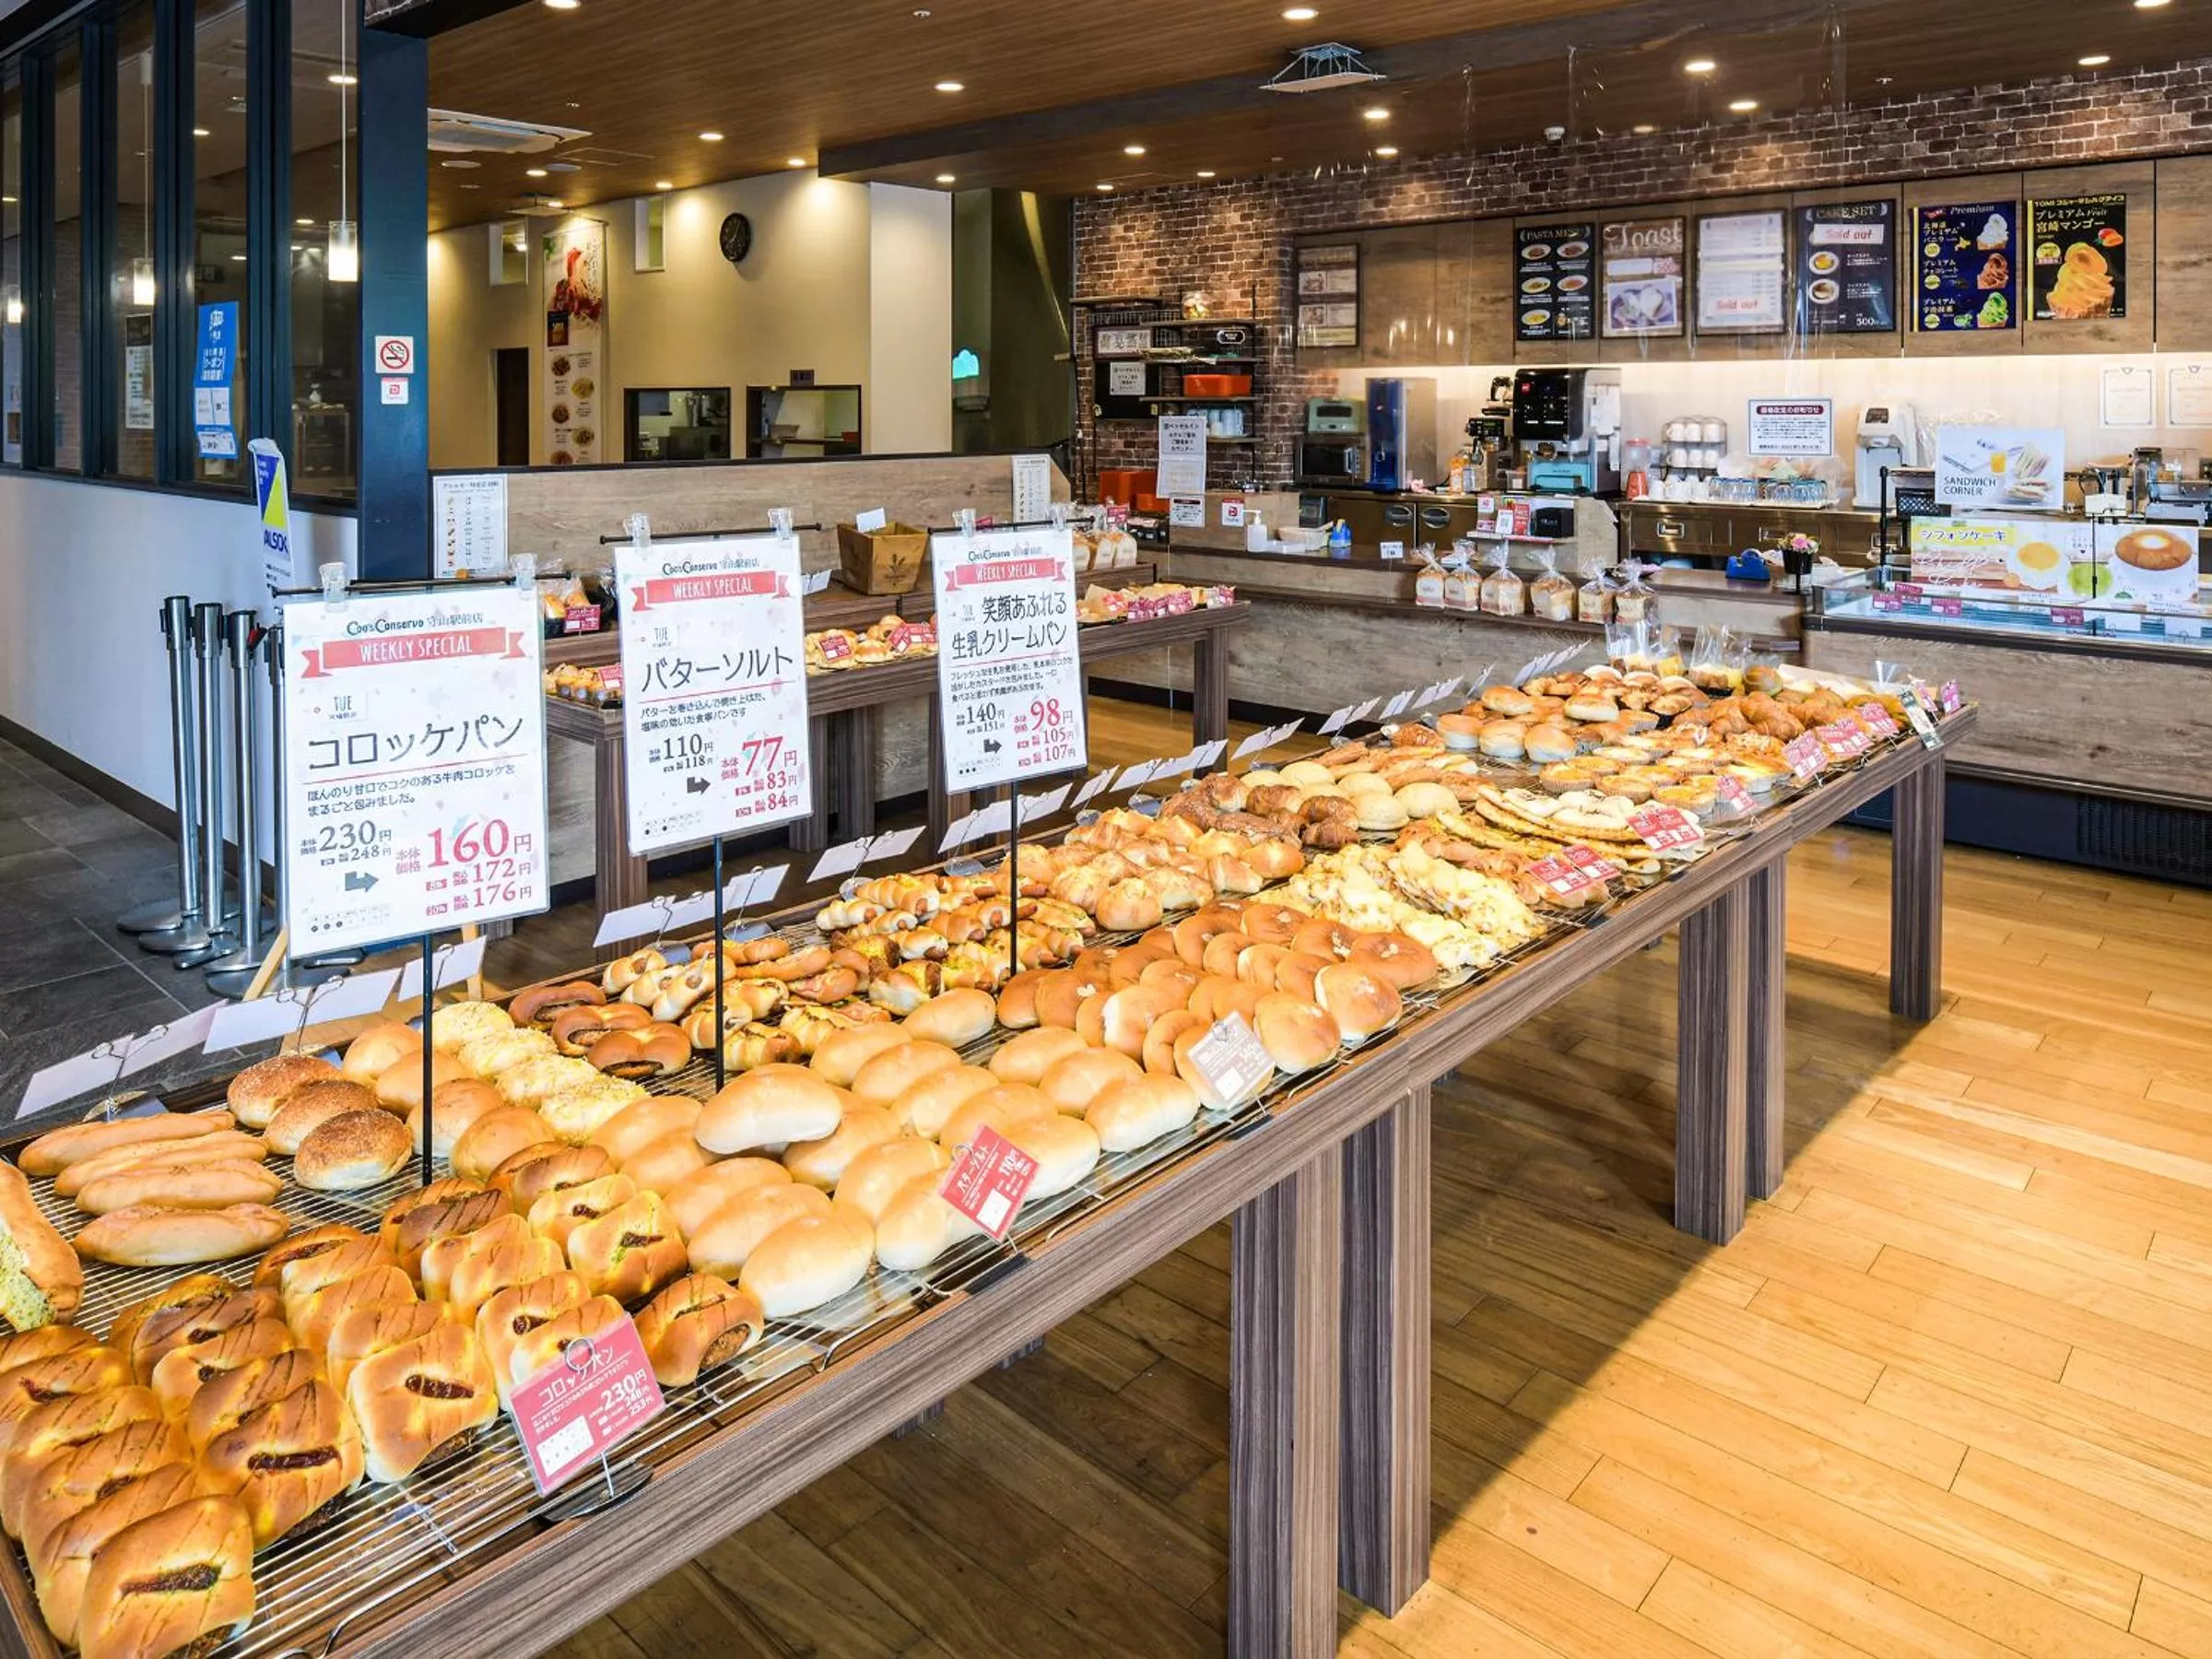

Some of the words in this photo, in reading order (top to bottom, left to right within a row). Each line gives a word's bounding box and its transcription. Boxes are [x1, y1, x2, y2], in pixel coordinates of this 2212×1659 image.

[1853, 206, 1877, 218] SET
[1950, 205, 1994, 215] Premium
[2036, 208, 2085, 220] プレミアム
[1603, 219, 1683, 251] Toast
[1853, 229, 1873, 240] out
[1741, 298, 1758, 309] out
[1943, 487, 1983, 496] CORNER
[1944, 477, 1996, 487] SANDWICH
[1922, 530, 2006, 541] シフォンケーキ
[673, 580, 712, 598] WEEKLY
[714, 576, 753, 595] SPECIAL
[982, 591, 1067, 624] 笑顔あふれる
[359, 639, 413, 663] WEEKLY
[418, 635, 472, 657] SPECIAL
[952, 619, 1067, 660] 生乳クリームパン
[641, 646, 794, 693] バターソルト
[334, 695, 352, 712] TUE
[1030, 698, 1073, 731] 98円
[309, 714, 524, 770] コロッケパン
[664, 734, 713, 759] 110円
[742, 735, 797, 775] 77円
[308, 764, 515, 801] ほんのり甘口でコクのある牛肉コロッケを
[767, 771, 797, 790] 83円
[308, 793, 415, 818] まるごと包みました。
[768, 791, 798, 810] 84円
[319, 819, 392, 852] 230円
[428, 818, 532, 867] 160円
[351, 844, 391, 862] 248円
[395, 845, 420, 860] 本体
[395, 861, 420, 875] 価格
[473, 858, 531, 883] 172円
[473, 881, 532, 908] 176円
[601, 1368, 647, 1412] 230円
